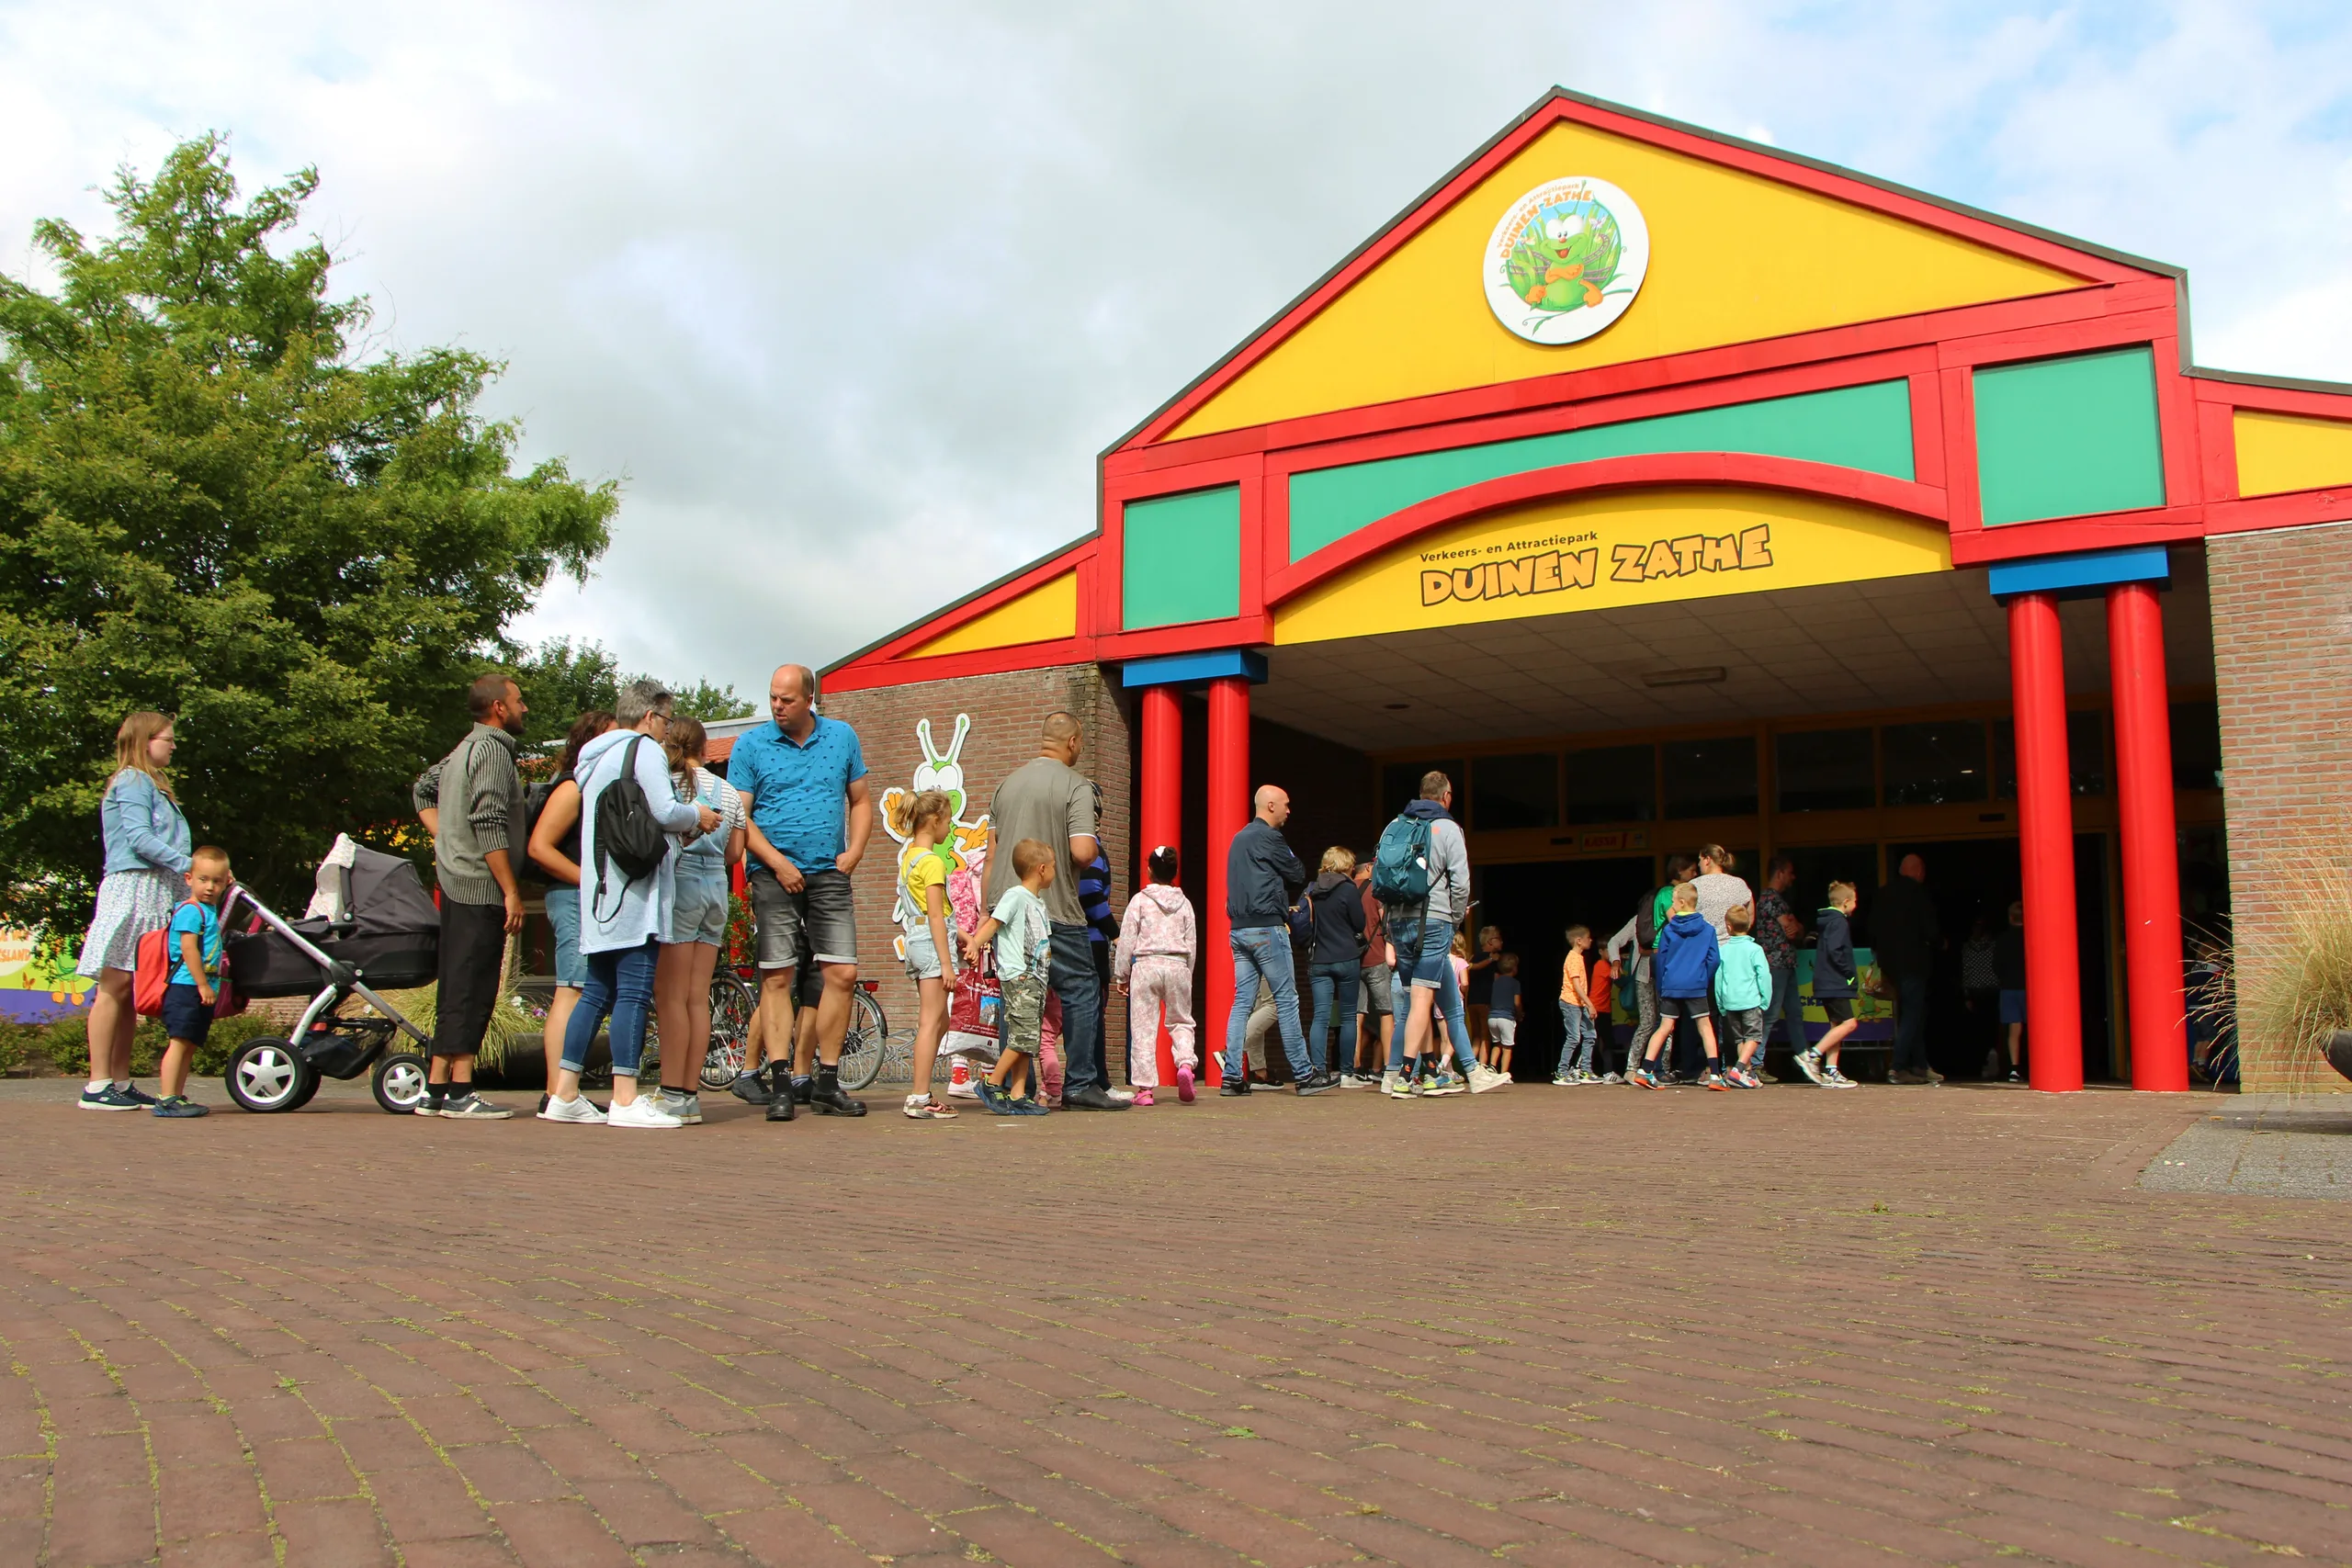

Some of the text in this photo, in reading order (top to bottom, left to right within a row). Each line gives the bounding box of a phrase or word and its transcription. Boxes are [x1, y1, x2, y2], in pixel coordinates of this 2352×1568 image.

[1499, 190, 1591, 258] DUINEN ZATHE
[1420, 531, 1598, 562] Verkeers- en Attractiepark
[1420, 524, 1773, 606] DUINEN ZATHE
